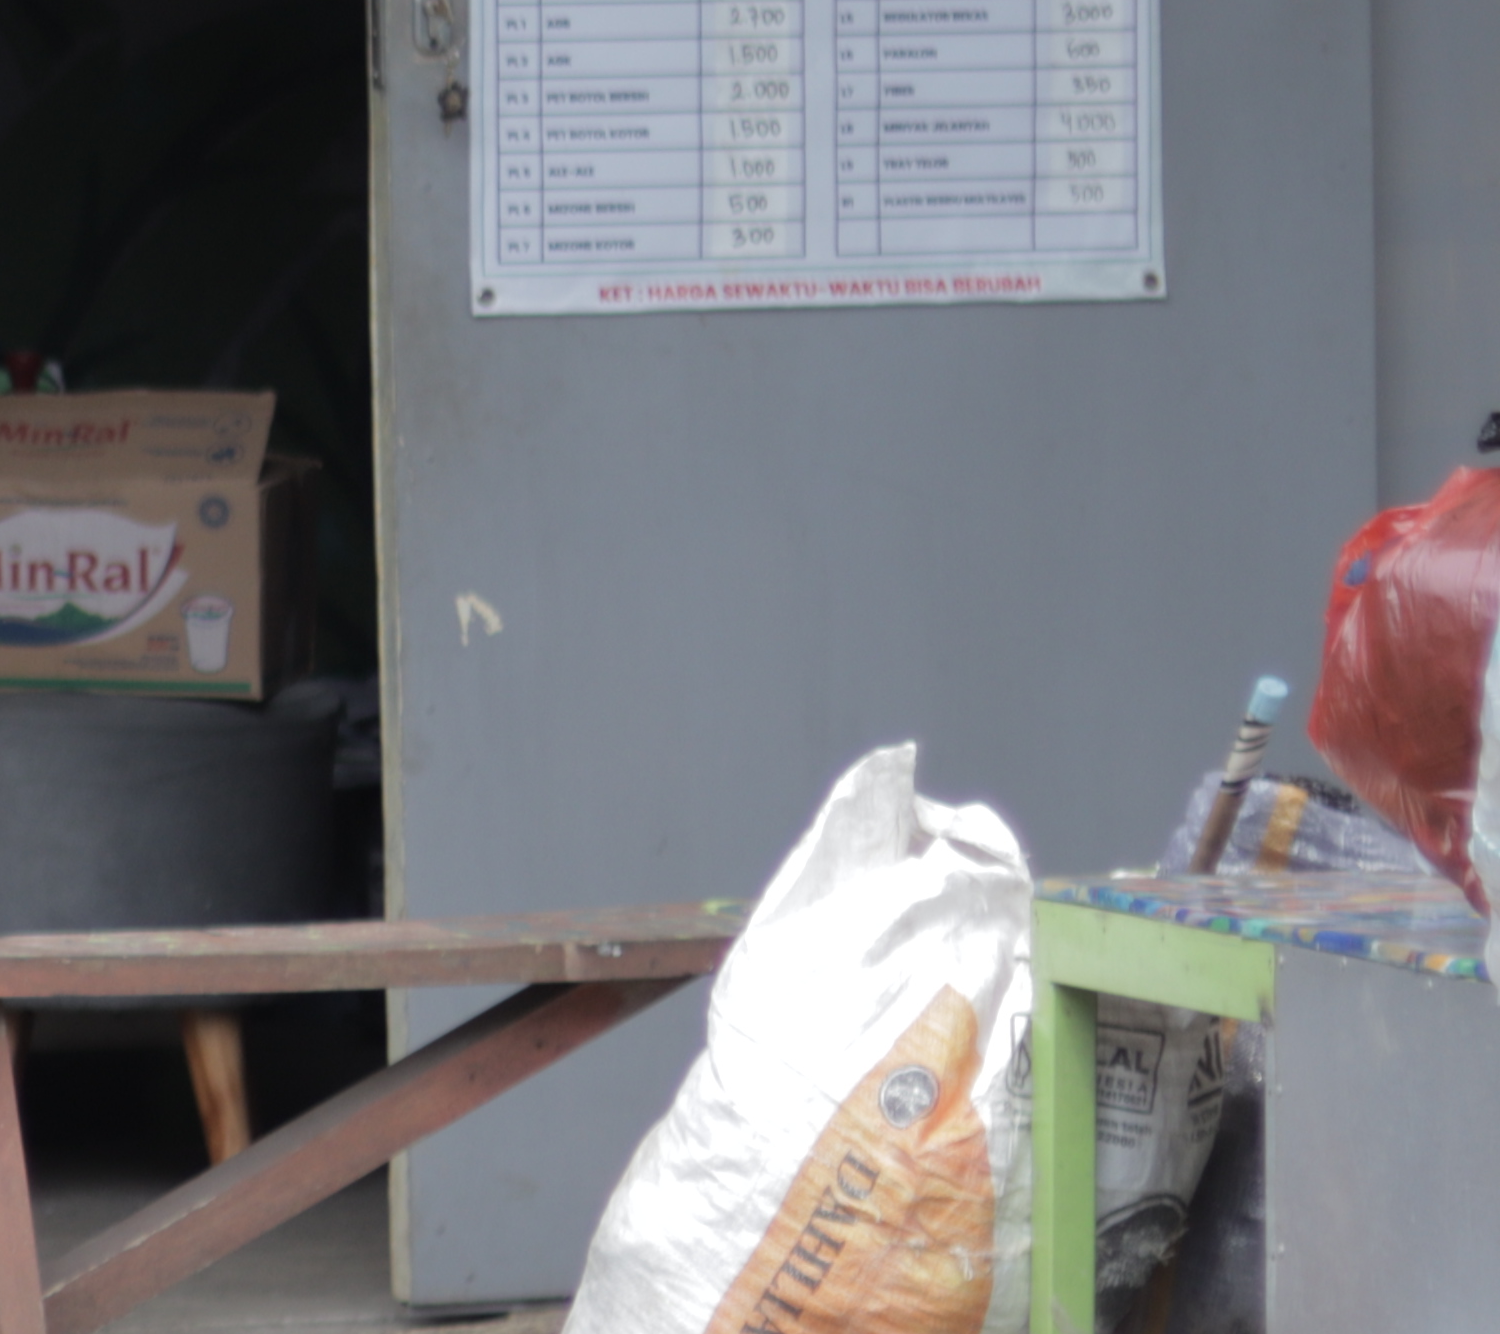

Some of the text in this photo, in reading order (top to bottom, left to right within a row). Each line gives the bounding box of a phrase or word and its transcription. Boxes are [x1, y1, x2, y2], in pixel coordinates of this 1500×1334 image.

[730, 8, 786, 29] 2.700
[728, 44, 779, 66] 1.500
[731, 81, 790, 102] 2.000
[729, 119, 782, 141] 1.500
[728, 194, 769, 215] 500
[731, 227, 775, 249] 300
[648, 285, 717, 304] HARGA
[905, 278, 948, 296] BISA
[952, 276, 1040, 294] BERUBAH
